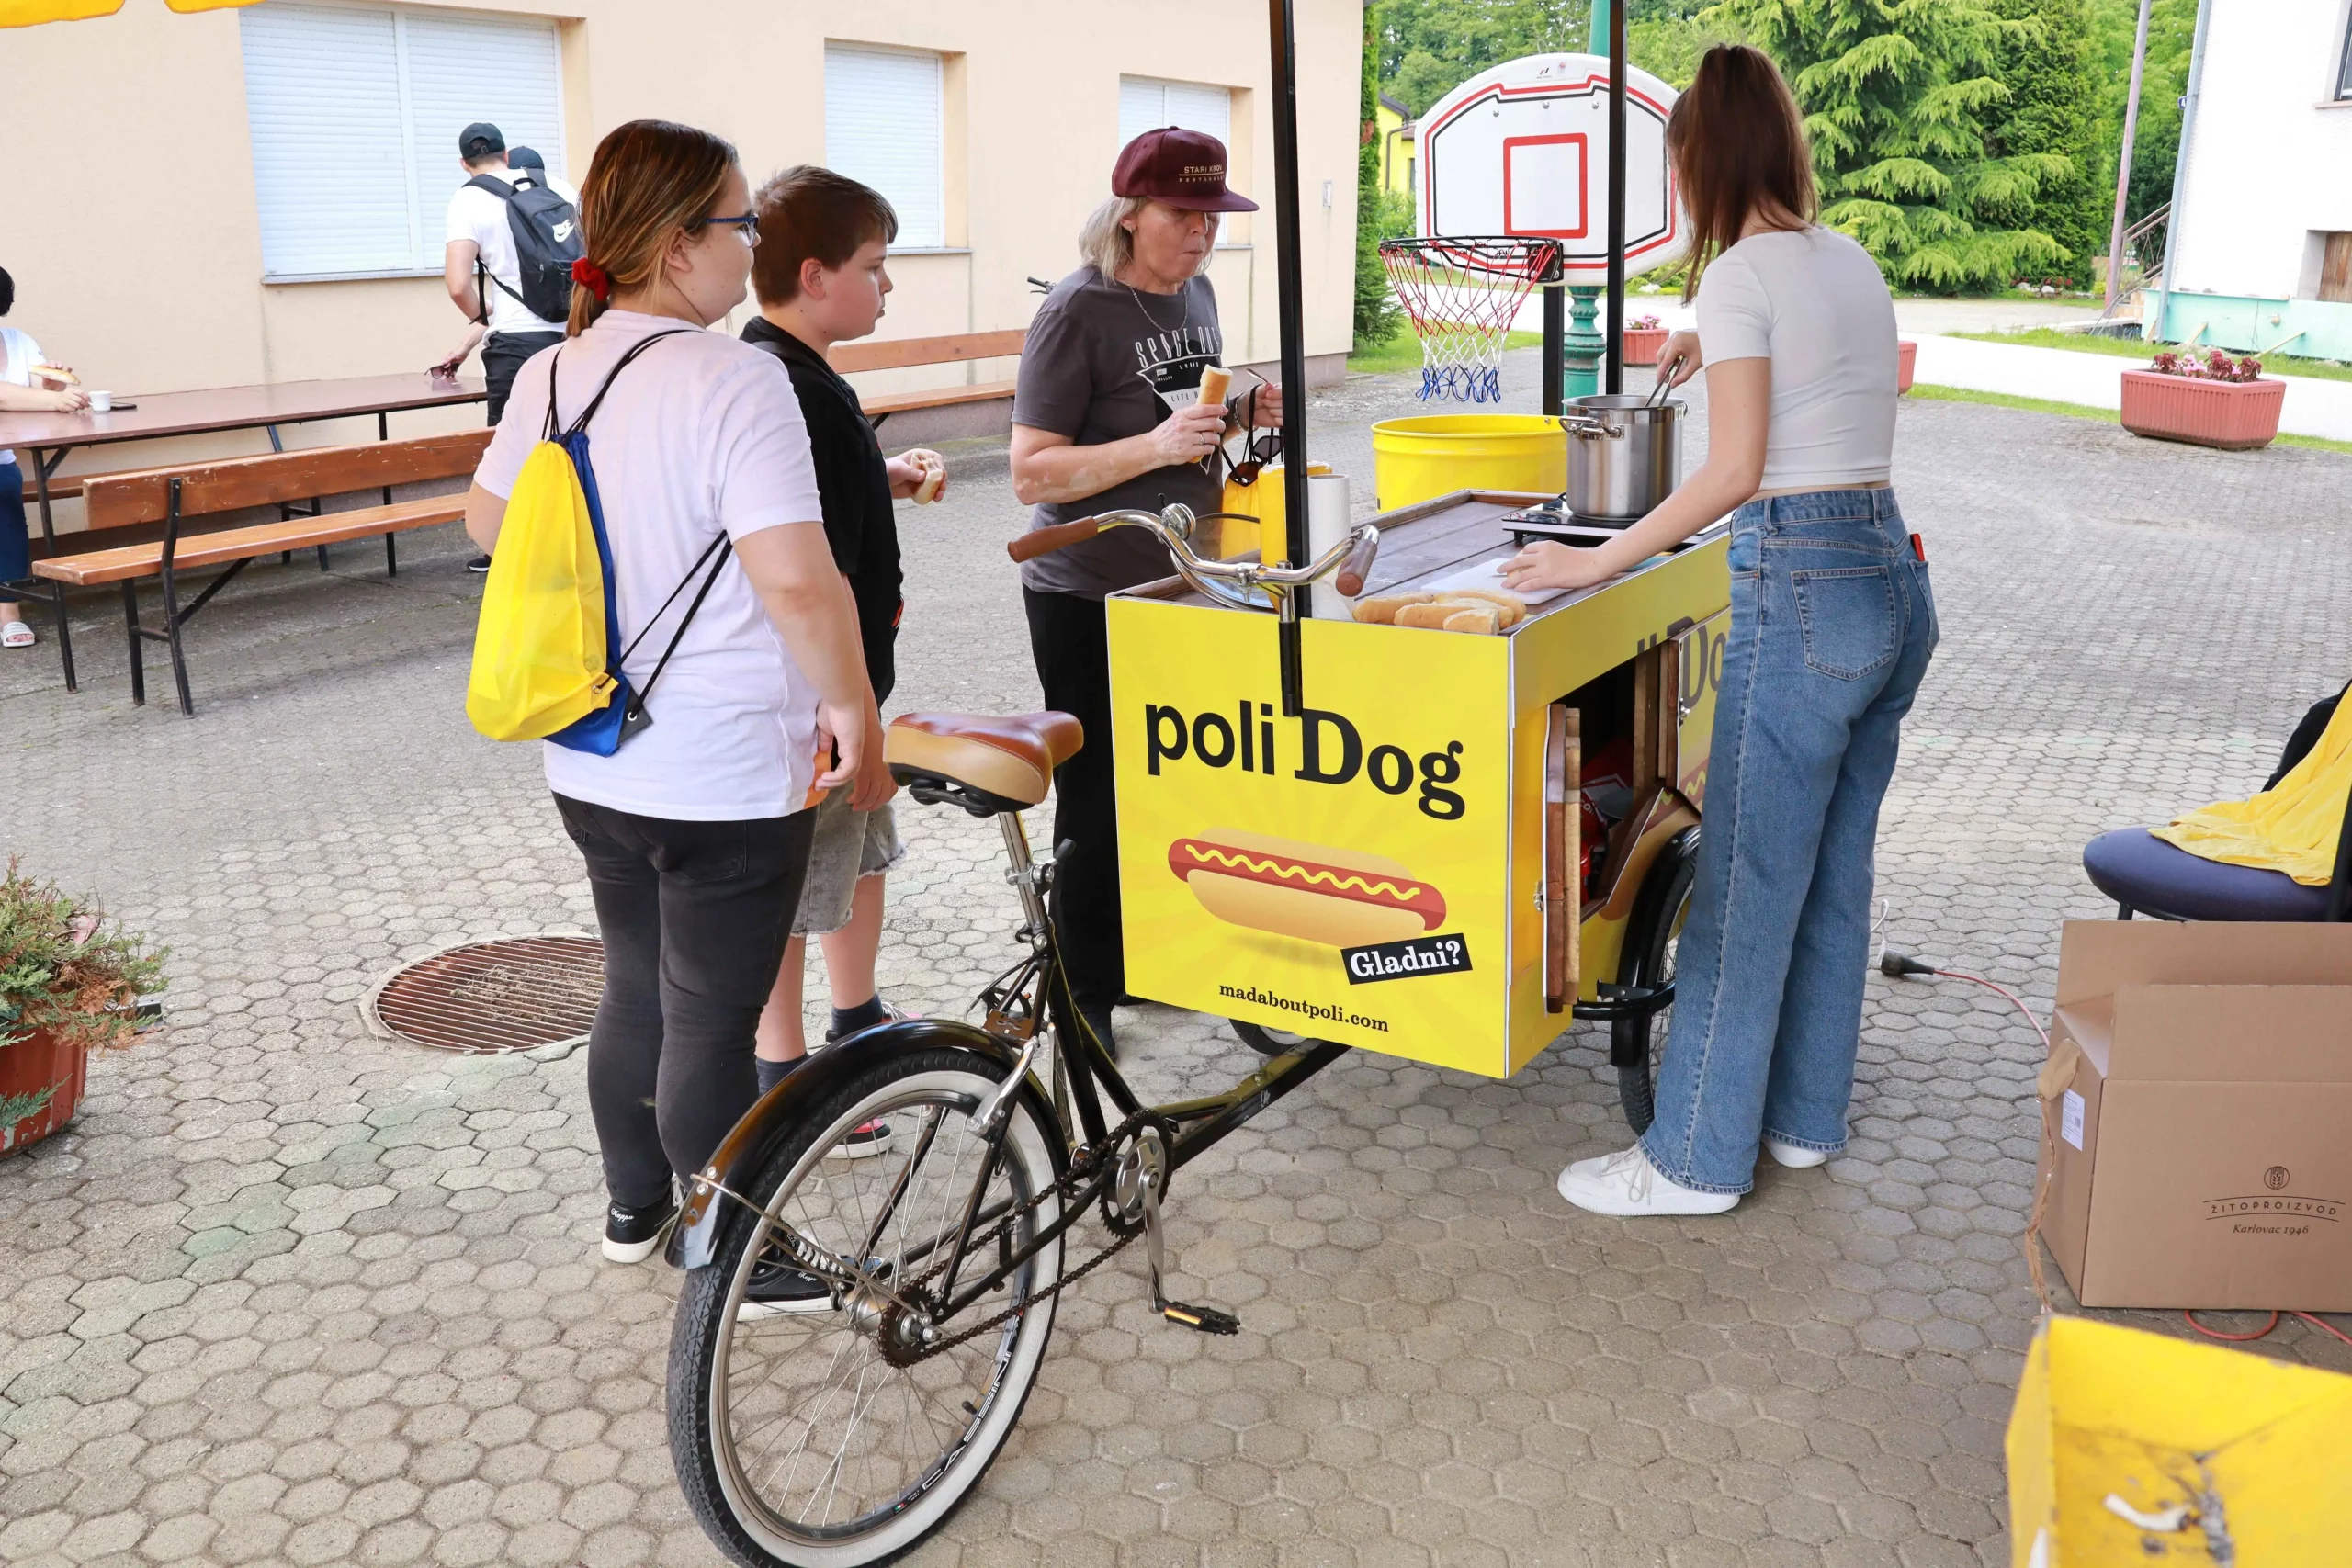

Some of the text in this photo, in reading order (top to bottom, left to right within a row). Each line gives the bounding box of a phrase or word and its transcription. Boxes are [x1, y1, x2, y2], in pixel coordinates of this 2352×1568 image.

[1183, 164, 1223, 174] STARI KROV
[1135, 328, 1193, 369] SPACE
[1170, 392, 1190, 402] LIFE
[1145, 699, 1466, 821] poli Dog
[1349, 940, 1462, 978] Gladni?
[1218, 983, 1390, 1033] madaboutpoli.com
[610, 1207, 635, 1223] Kappa
[2211, 1201, 2336, 1215] ŽITOPROIZVOD
[2232, 1224, 2310, 1235] Karlovac 1946
